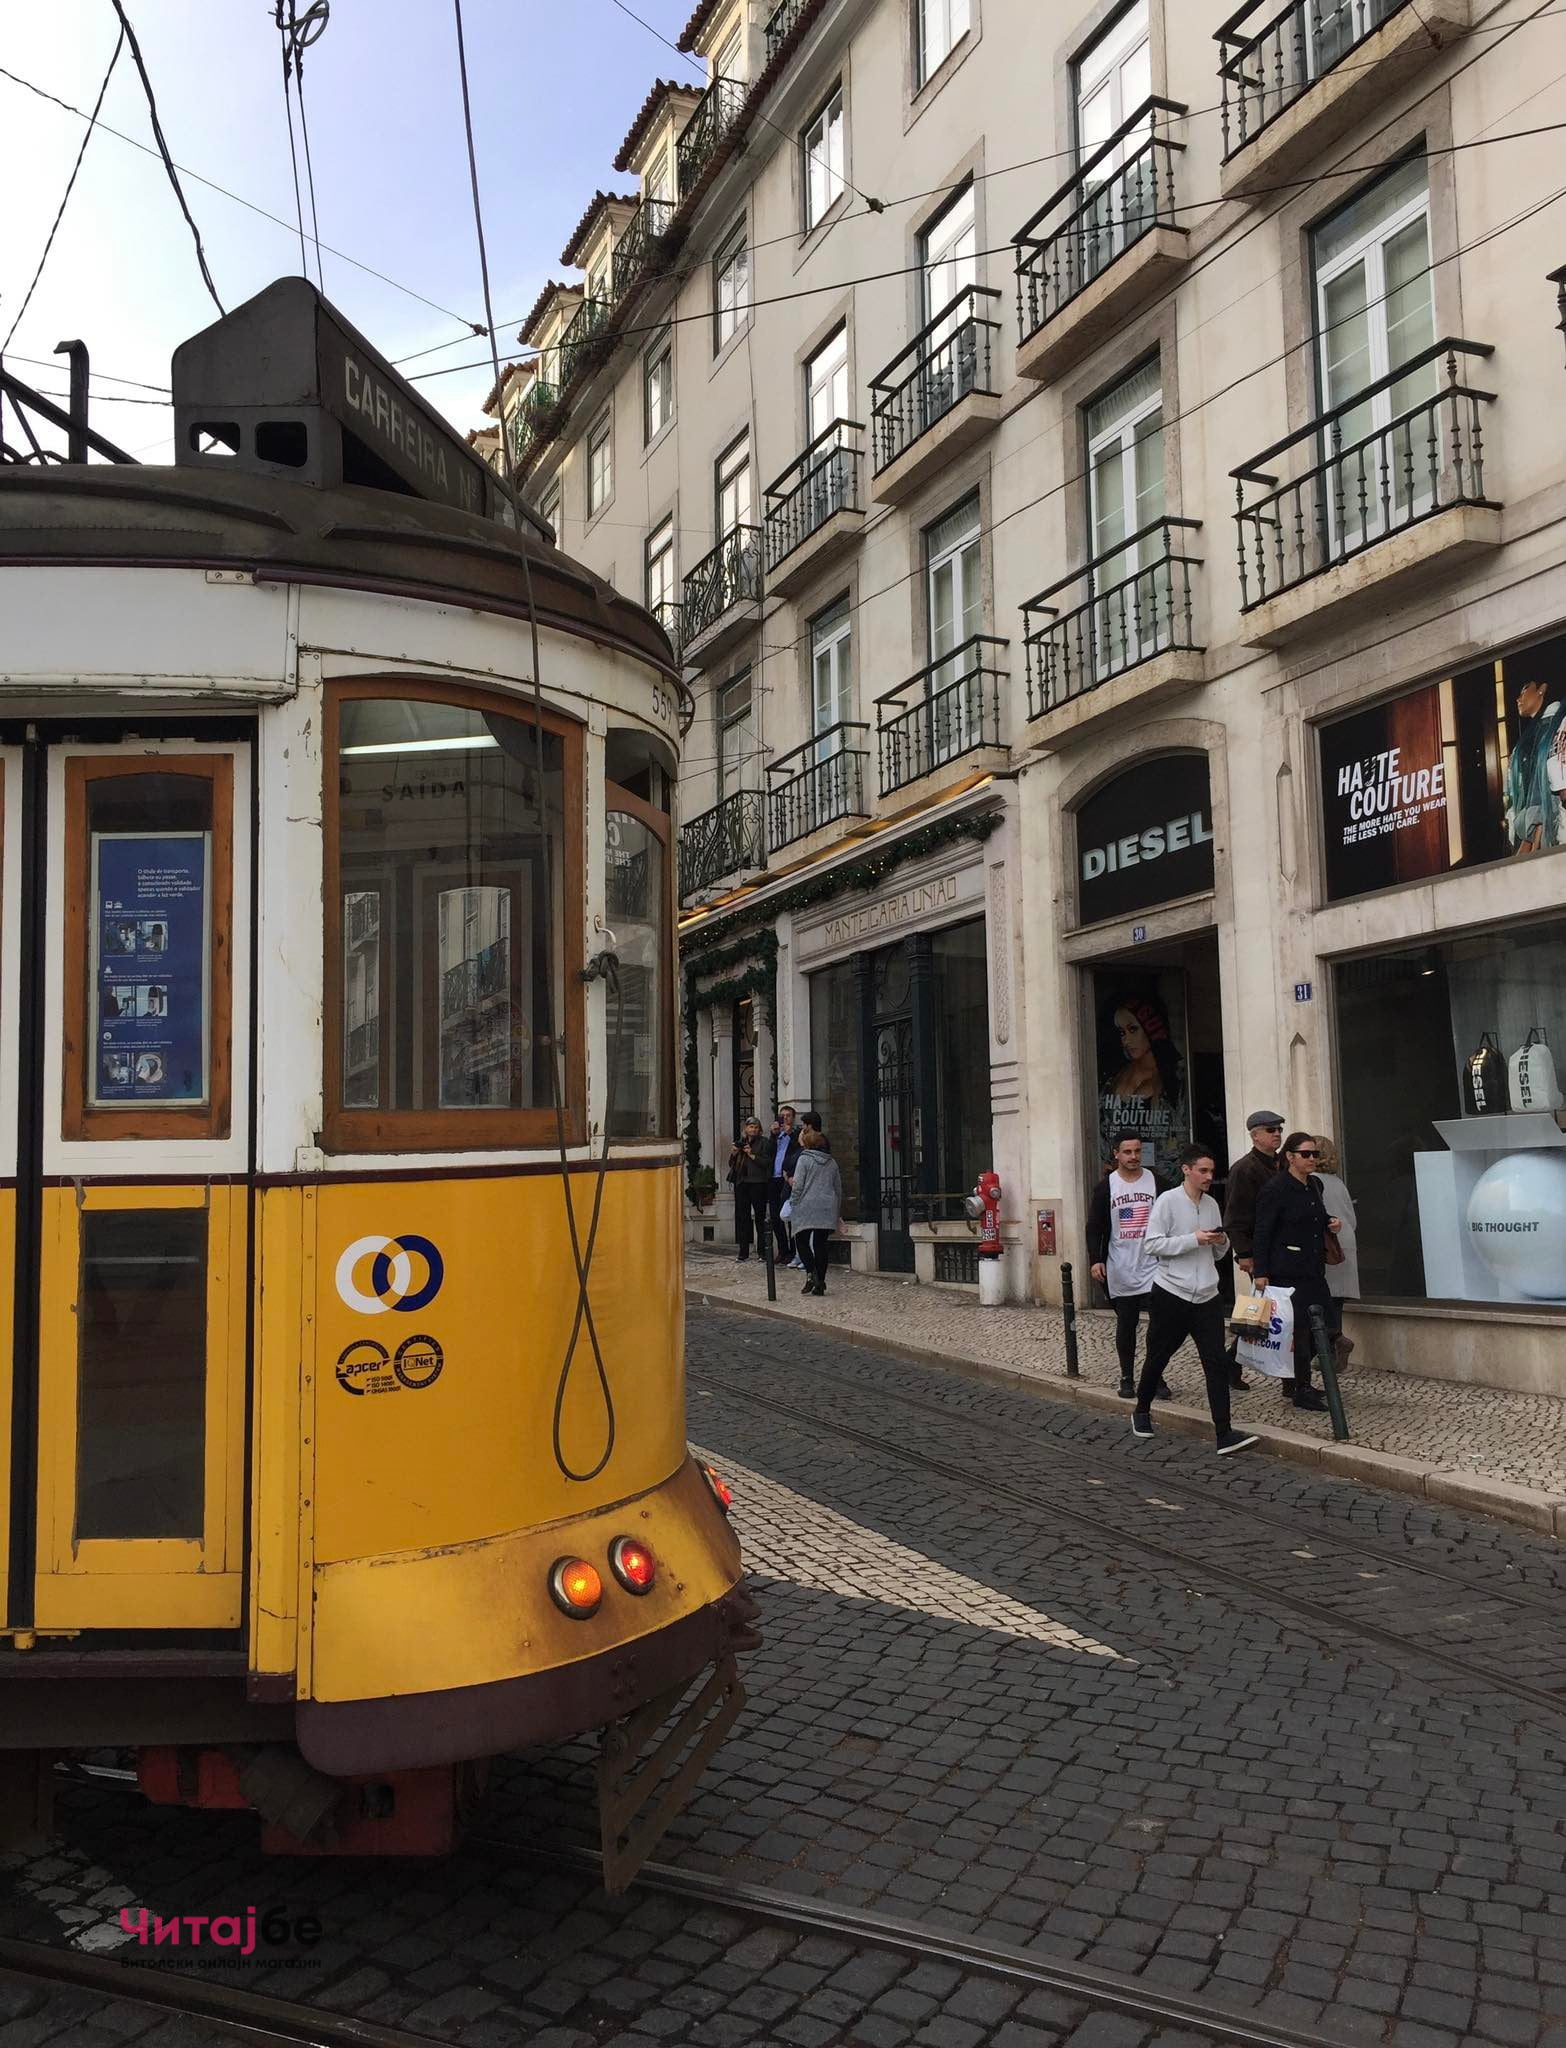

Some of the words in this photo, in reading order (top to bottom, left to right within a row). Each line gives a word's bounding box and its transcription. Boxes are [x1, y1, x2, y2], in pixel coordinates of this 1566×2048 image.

[345, 356, 448, 493] CARREIRA
[652, 685, 672, 725] 559
[1350, 763, 1445, 820] COUTURE
[1343, 824, 1358, 836] THE
[1359, 817, 1381, 831] MORE
[1382, 811, 1402, 822] HATE
[1404, 805, 1420, 817] YOU
[1343, 833, 1357, 845] THE
[1358, 828, 1378, 841] LESS
[1379, 822, 1395, 834] YOU
[1396, 815, 1420, 829] CARE.
[1082, 810, 1214, 881] DIESEL
[825, 895, 910, 945] MANTEIGARIA
[913, 877, 957, 913] UNIÃO
[1134, 928, 1144, 941] 30
[1297, 984, 1308, 1000] 31
[1105, 1094, 1145, 1110] HATE
[1113, 1110, 1170, 1125] COUTURE
[1471, 1222, 1483, 1232] BIG
[1484, 1221, 1539, 1232] THOUGHT
[346, 1361, 382, 1376] apcer
